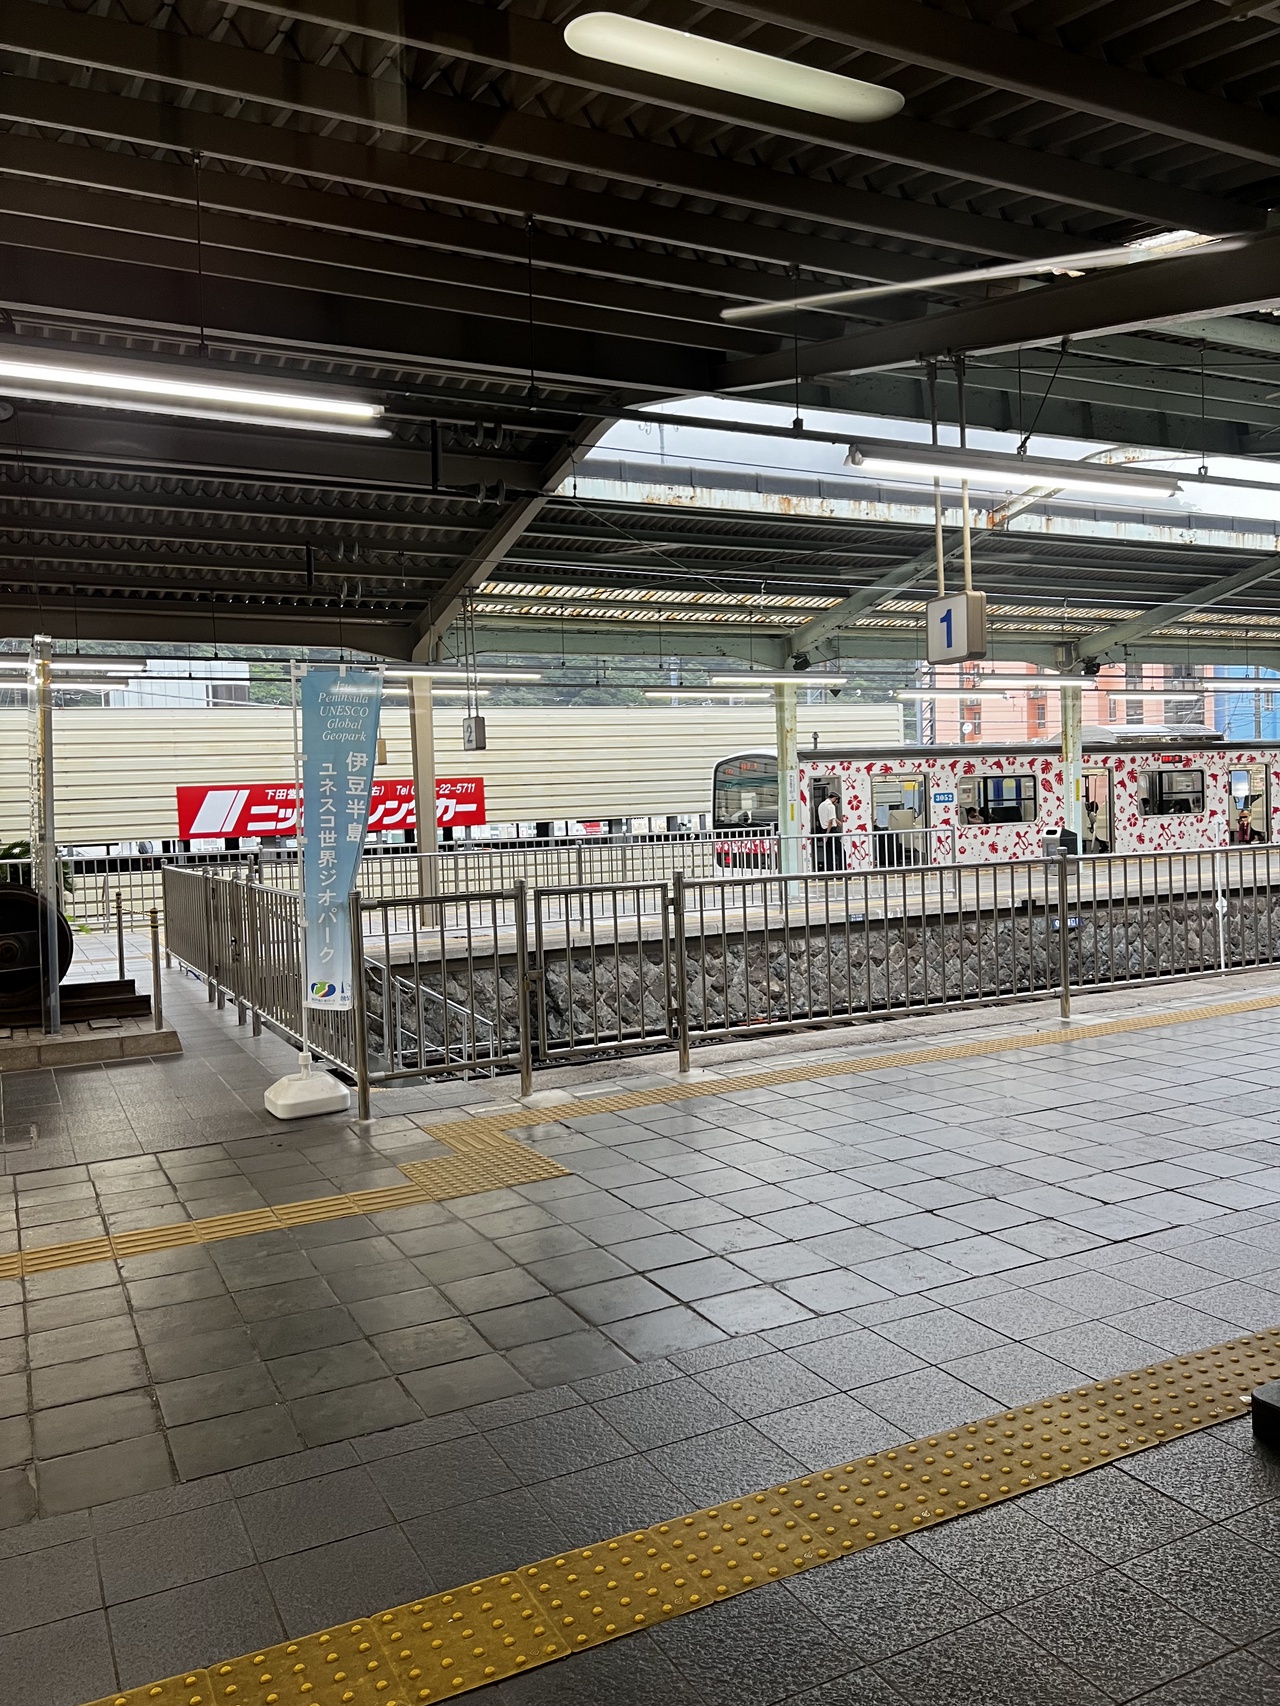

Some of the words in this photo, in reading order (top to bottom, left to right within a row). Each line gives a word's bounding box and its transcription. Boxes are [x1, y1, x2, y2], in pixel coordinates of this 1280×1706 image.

[940, 608, 953, 649] 1
[318, 692, 369, 704] Peninsula
[320, 705, 369, 717] UNESCO
[327, 718, 362, 729] Global
[322, 730, 367, 742] Geopark
[466, 723, 473, 744] 2
[346, 751, 368, 842] 伊豆半島
[396, 785, 409, 796] Tel
[935, 794, 953, 803] 3052
[318, 763, 337, 963] ユネスコ世界ジオパーク
